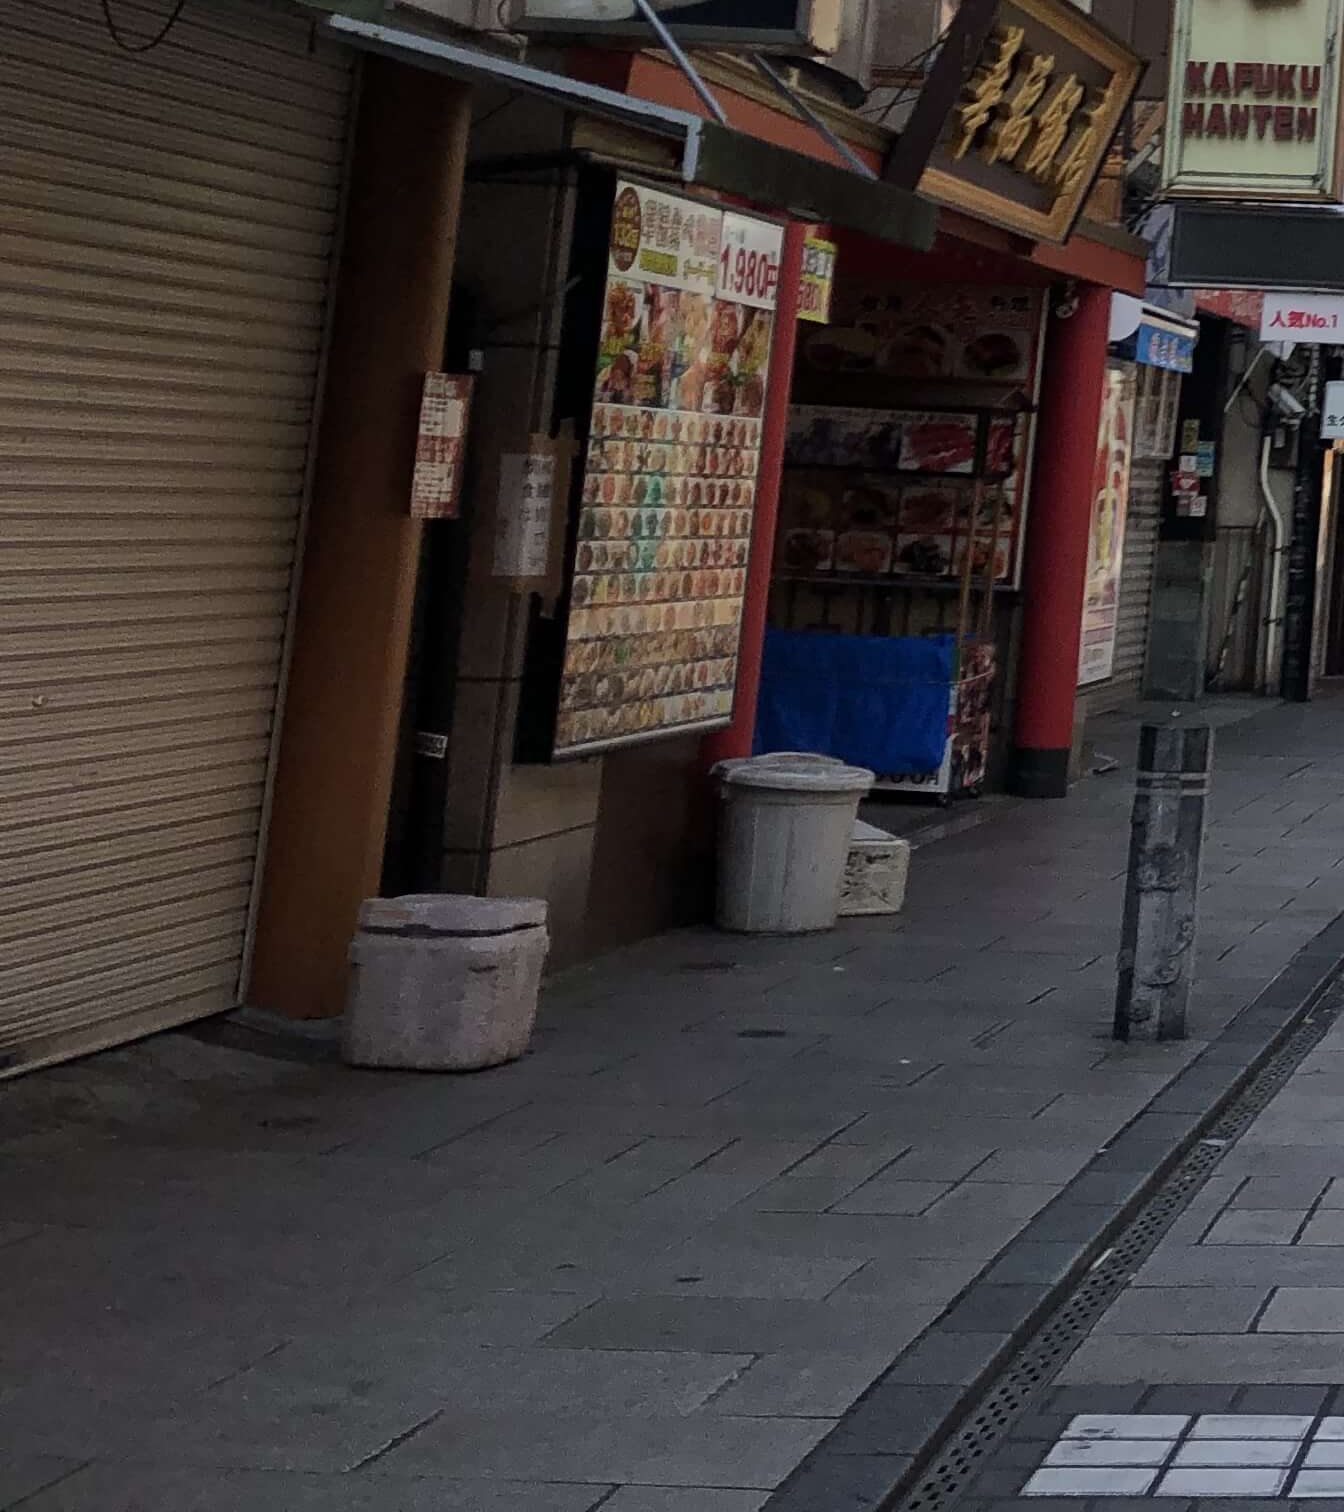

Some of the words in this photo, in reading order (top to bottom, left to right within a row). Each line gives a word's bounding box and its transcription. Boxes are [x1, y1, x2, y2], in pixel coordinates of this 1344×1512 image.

[1185, 61, 1322, 99] KAFUKU
[1182, 102, 1319, 144] HANTEN
[1269, 310, 1339, 329] 人気No.1
